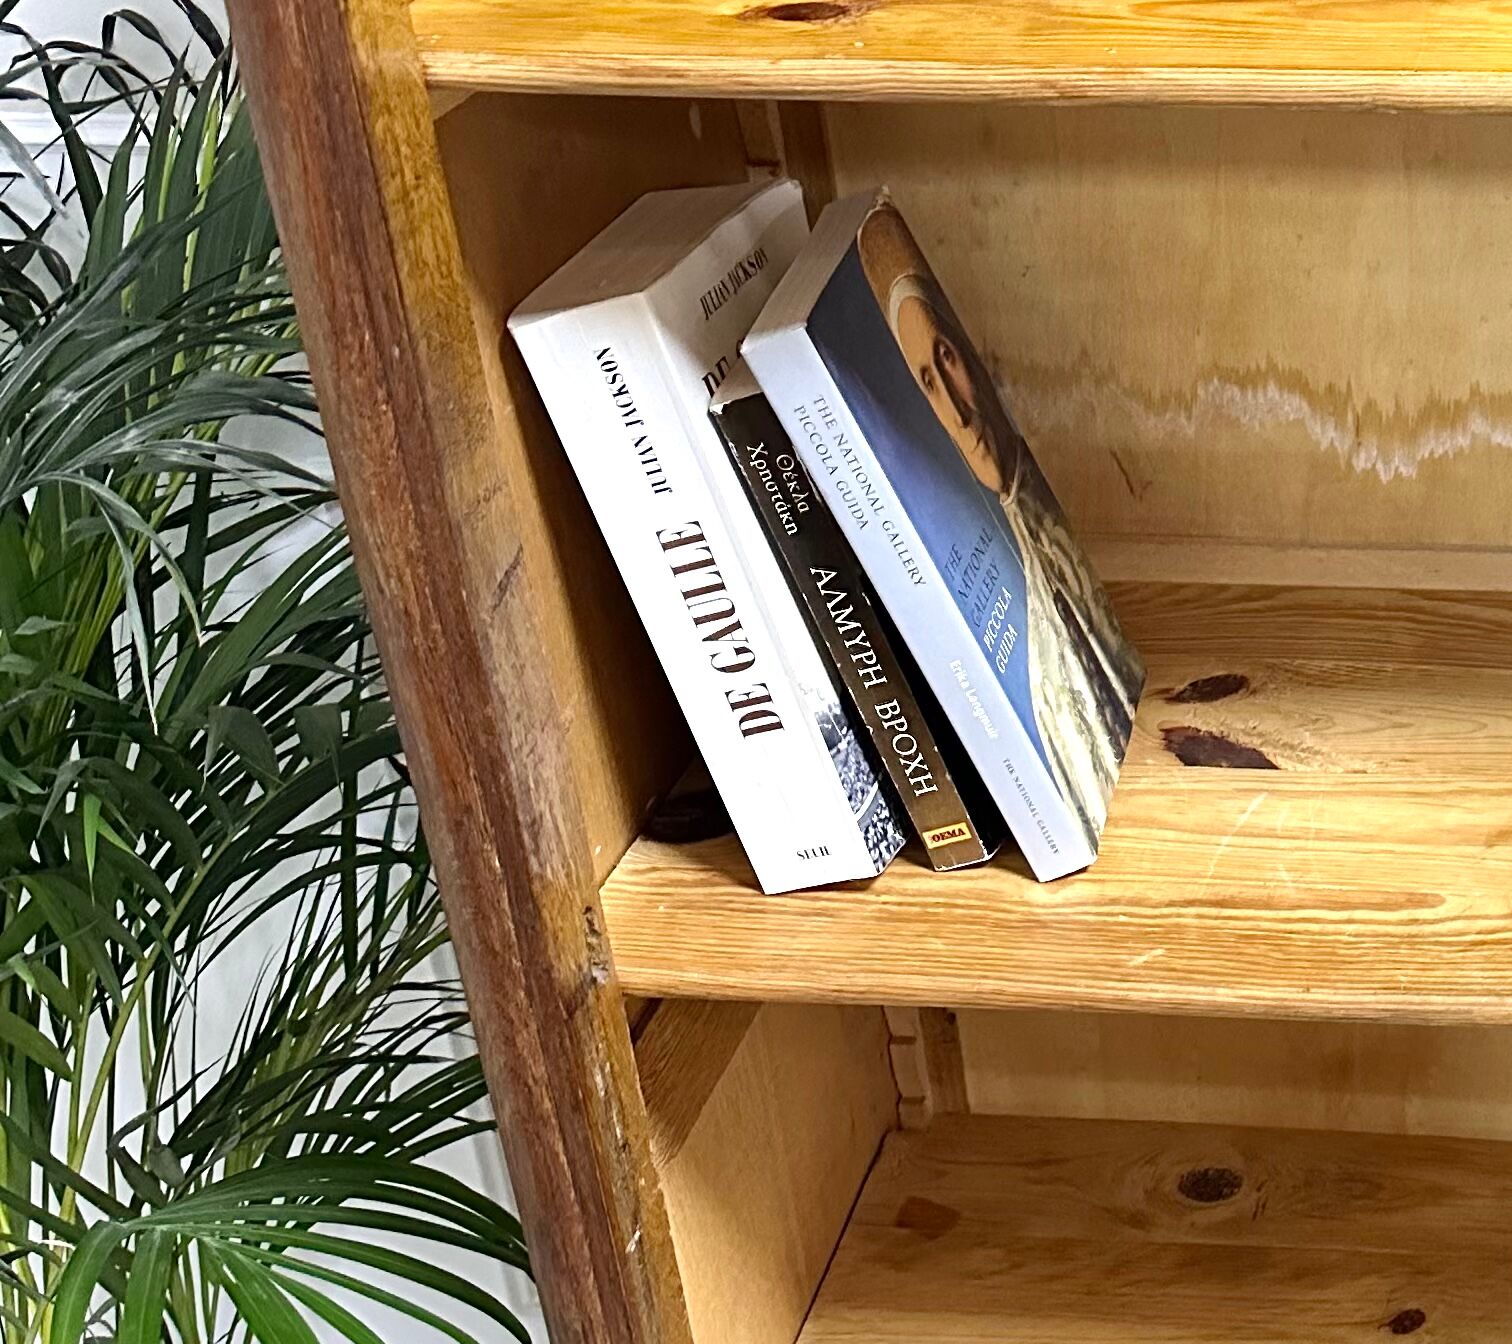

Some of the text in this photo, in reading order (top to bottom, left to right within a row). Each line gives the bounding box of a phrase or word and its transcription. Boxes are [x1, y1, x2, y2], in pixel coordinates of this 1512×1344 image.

[700, 247, 769, 320] JULIAN JACKSON
[592, 347, 673, 494] JULIAN JACKSON
[746, 442, 798, 536] Χρηστάκη
[776, 454, 809, 513] Θέκλα
[794, 405, 870, 531] PICCOLA GUIDA
[813, 395, 927, 587] THE NATIONAL GALLERY
[945, 543, 963, 581] THE
[958, 527, 993, 599] NATIONAL
[972, 561, 1000, 628] GALLERY
[656, 521, 785, 739] DE GAULLE
[983, 586, 1013, 653] PICCOLA
[995, 623, 1018, 674] GUIDA
[809, 566, 939, 797] ΑΛΜΥΡΗ ΒΡΟΧΗ
[950, 659, 970, 689] Erika
[1003, 758, 1060, 854] THE NATIONAL GALLERY
